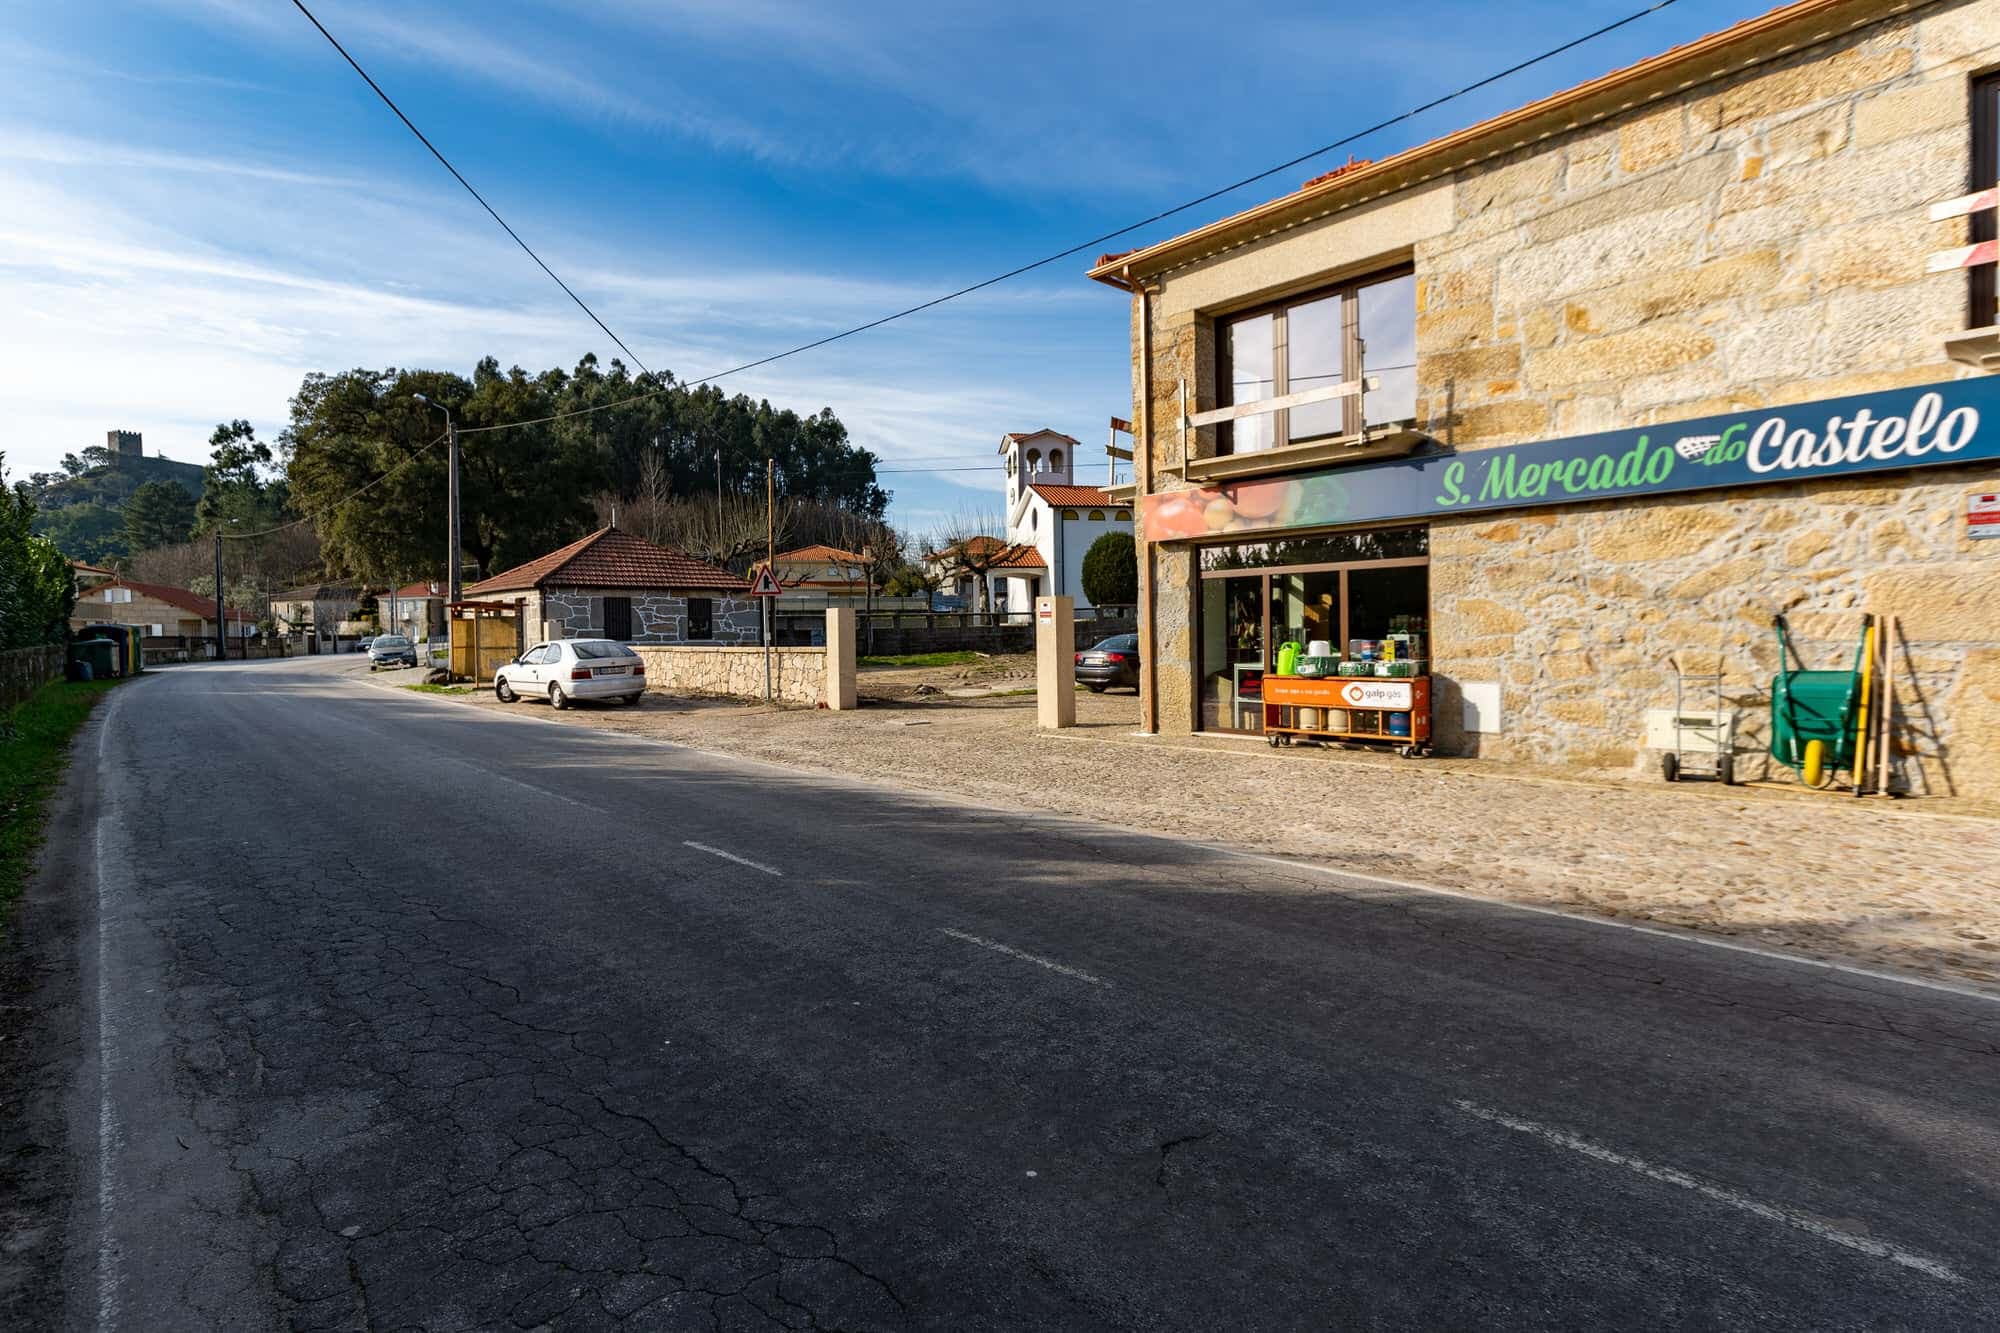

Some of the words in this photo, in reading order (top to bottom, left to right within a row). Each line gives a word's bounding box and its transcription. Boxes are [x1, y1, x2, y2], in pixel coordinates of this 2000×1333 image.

[1435, 461, 1471, 506] S.
[1478, 435, 1676, 502] Mercado
[1701, 422, 1748, 466] do
[1746, 392, 1980, 474] Castelo
[1365, 689, 1385, 699] galp
